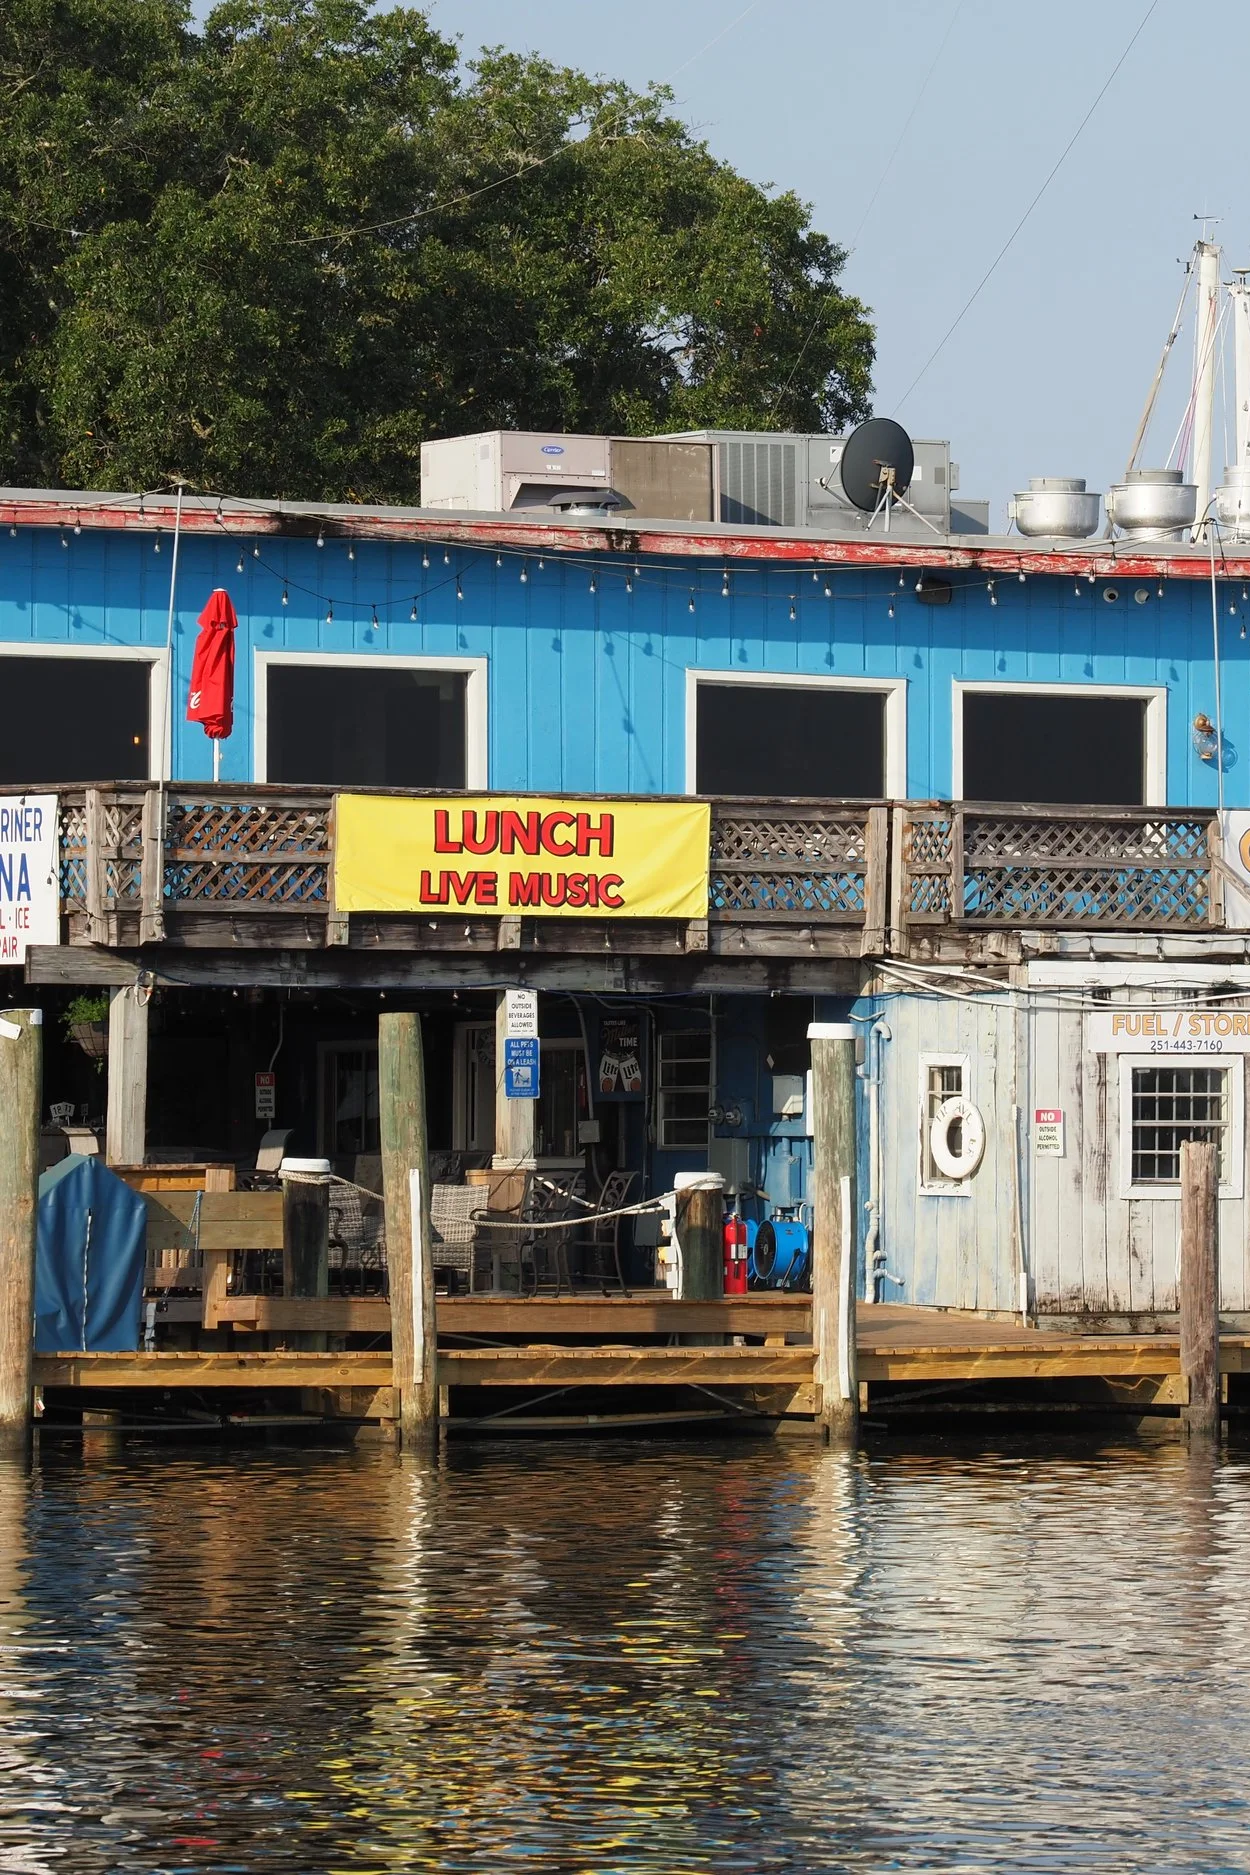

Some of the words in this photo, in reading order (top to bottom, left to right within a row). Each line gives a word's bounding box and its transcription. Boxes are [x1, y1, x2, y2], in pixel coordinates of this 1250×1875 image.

[433, 809, 615, 857] LUNCH
[419, 870, 498, 906] LIVE
[508, 872, 626, 909] MUSIC
[15, 907, 30, 929] ICE
[0, 936, 18, 958] AIR
[1112, 1014, 1168, 1036] FUEL
[1173, 1013, 1184, 1037] /
[619, 1037, 638, 1047] TIME
[1150, 1039, 1223, 1051] 251-443-7160
[260, 1075, 270, 1086] NO
[1040, 1112, 1055, 1122] NO
